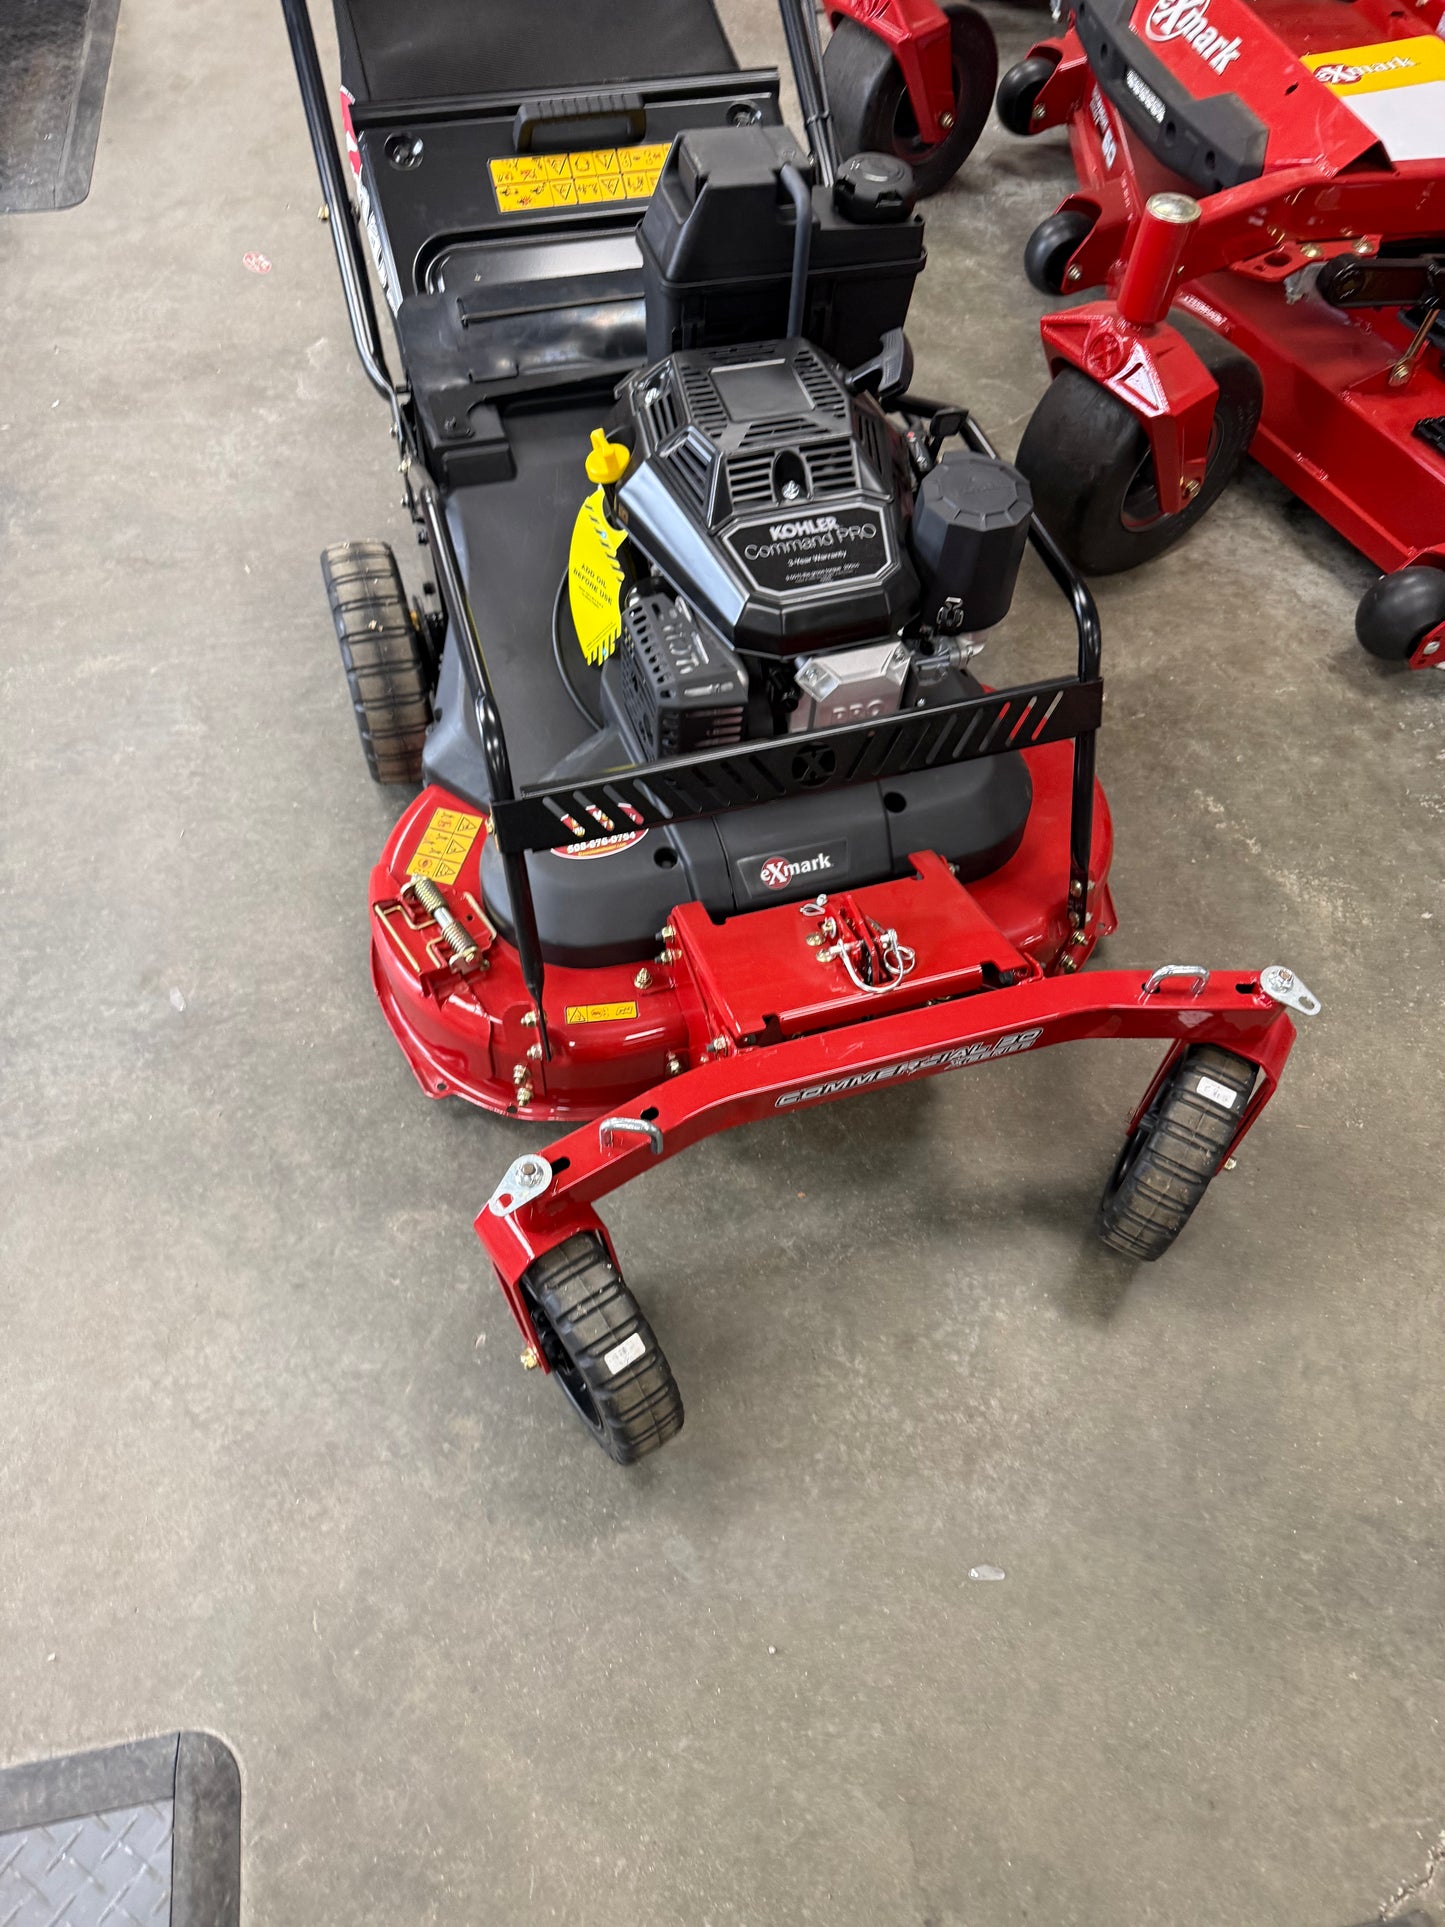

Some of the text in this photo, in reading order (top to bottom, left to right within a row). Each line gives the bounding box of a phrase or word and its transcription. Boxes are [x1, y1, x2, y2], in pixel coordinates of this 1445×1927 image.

[744, 523, 877, 560] Command PRO
[769, 516, 839, 541] KOHLER
[573, 567, 598, 594] BEFORE
[598, 590, 613, 605] USE
[580, 563, 607, 590] ADD OIL
[760, 852, 831, 885] eXmark
[775, 1042, 993, 1107] COMMERCIAL
